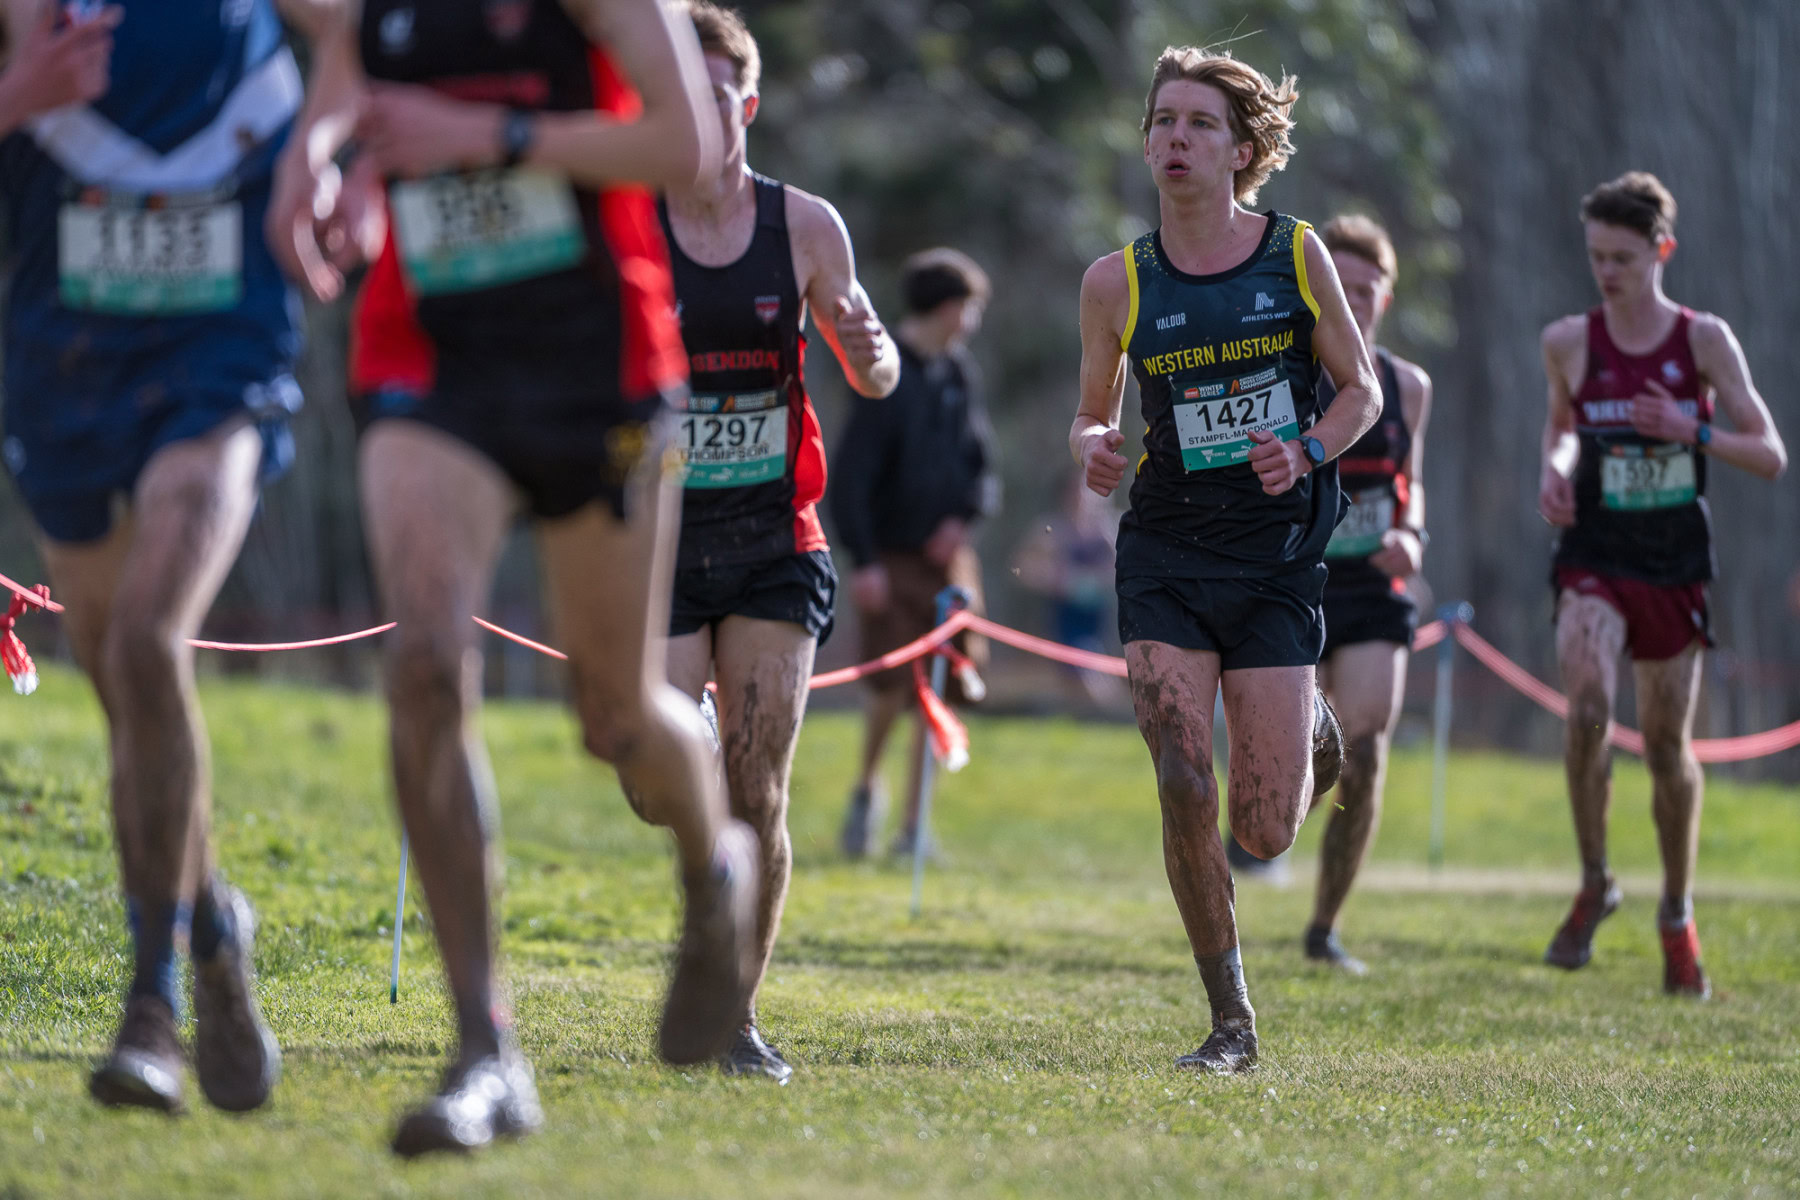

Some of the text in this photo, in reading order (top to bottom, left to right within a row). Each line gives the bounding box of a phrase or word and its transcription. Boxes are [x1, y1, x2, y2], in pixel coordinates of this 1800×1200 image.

[1156, 312, 1187, 331] VALOUR
[1241, 311, 1291, 323] ATHLETICS WEST
[1142, 329, 1294, 376] WESTERN AUSTRALIA
[1200, 389, 1220, 398] SERIES
[1197, 389, 1272, 432] 1427
[681, 416, 767, 448] 1297
[1626, 456, 1670, 483] 597
